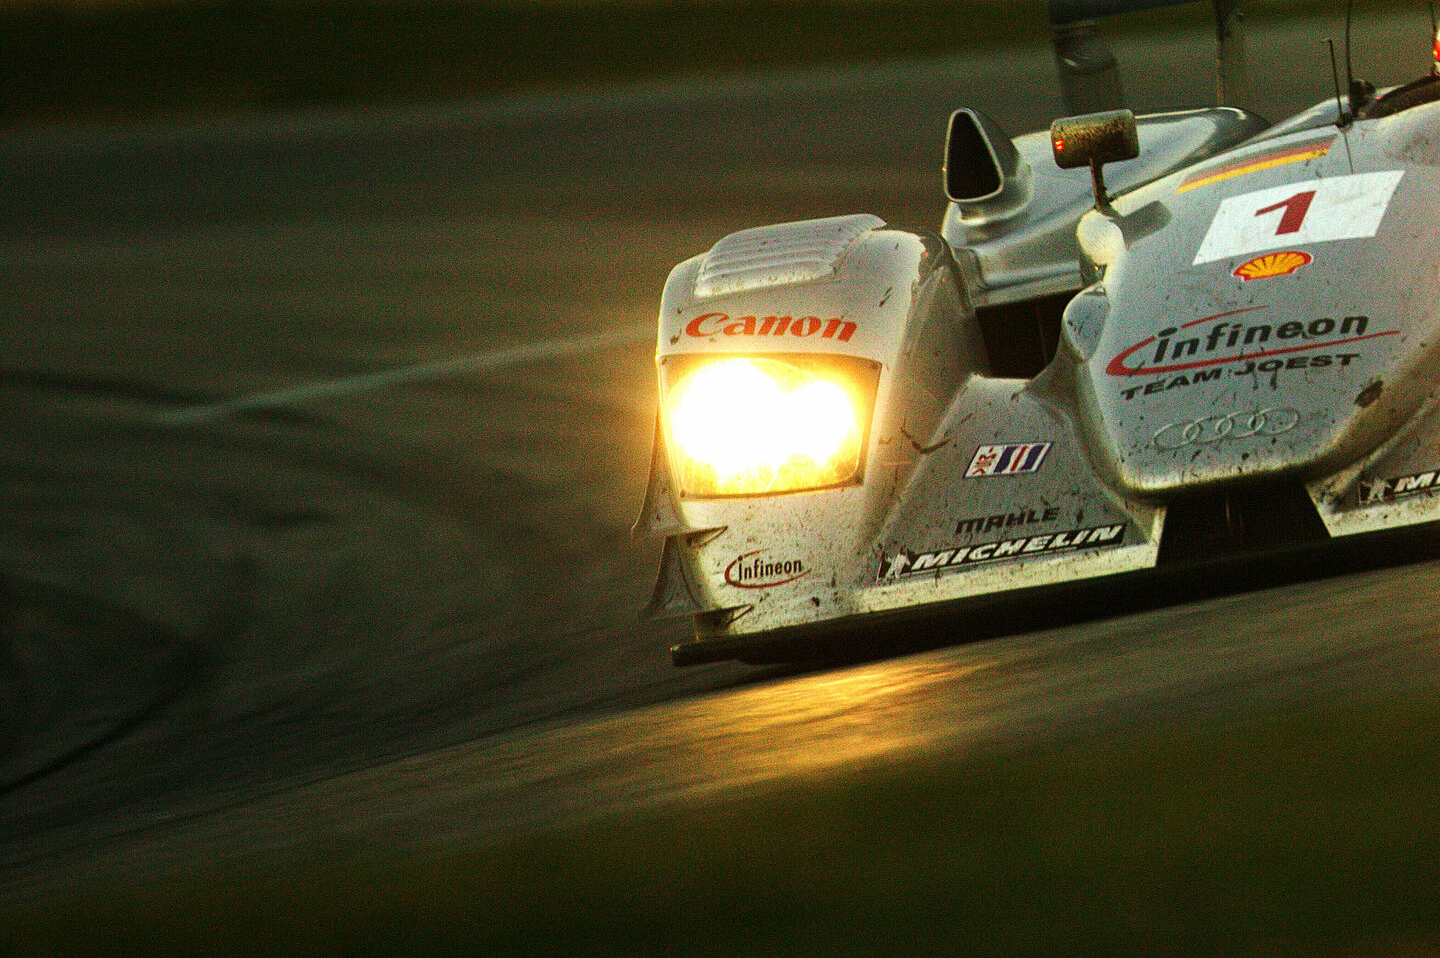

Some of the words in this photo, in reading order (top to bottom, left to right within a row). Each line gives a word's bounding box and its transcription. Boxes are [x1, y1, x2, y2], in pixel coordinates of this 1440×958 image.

[1254, 190, 1317, 236] 1
[685, 312, 858, 342] Canon
[1120, 368, 1222, 401] TEAM
[1234, 352, 1360, 376] JOEST
[955, 507, 1060, 535] MAHLE
[910, 524, 1123, 571] MICHELIN
